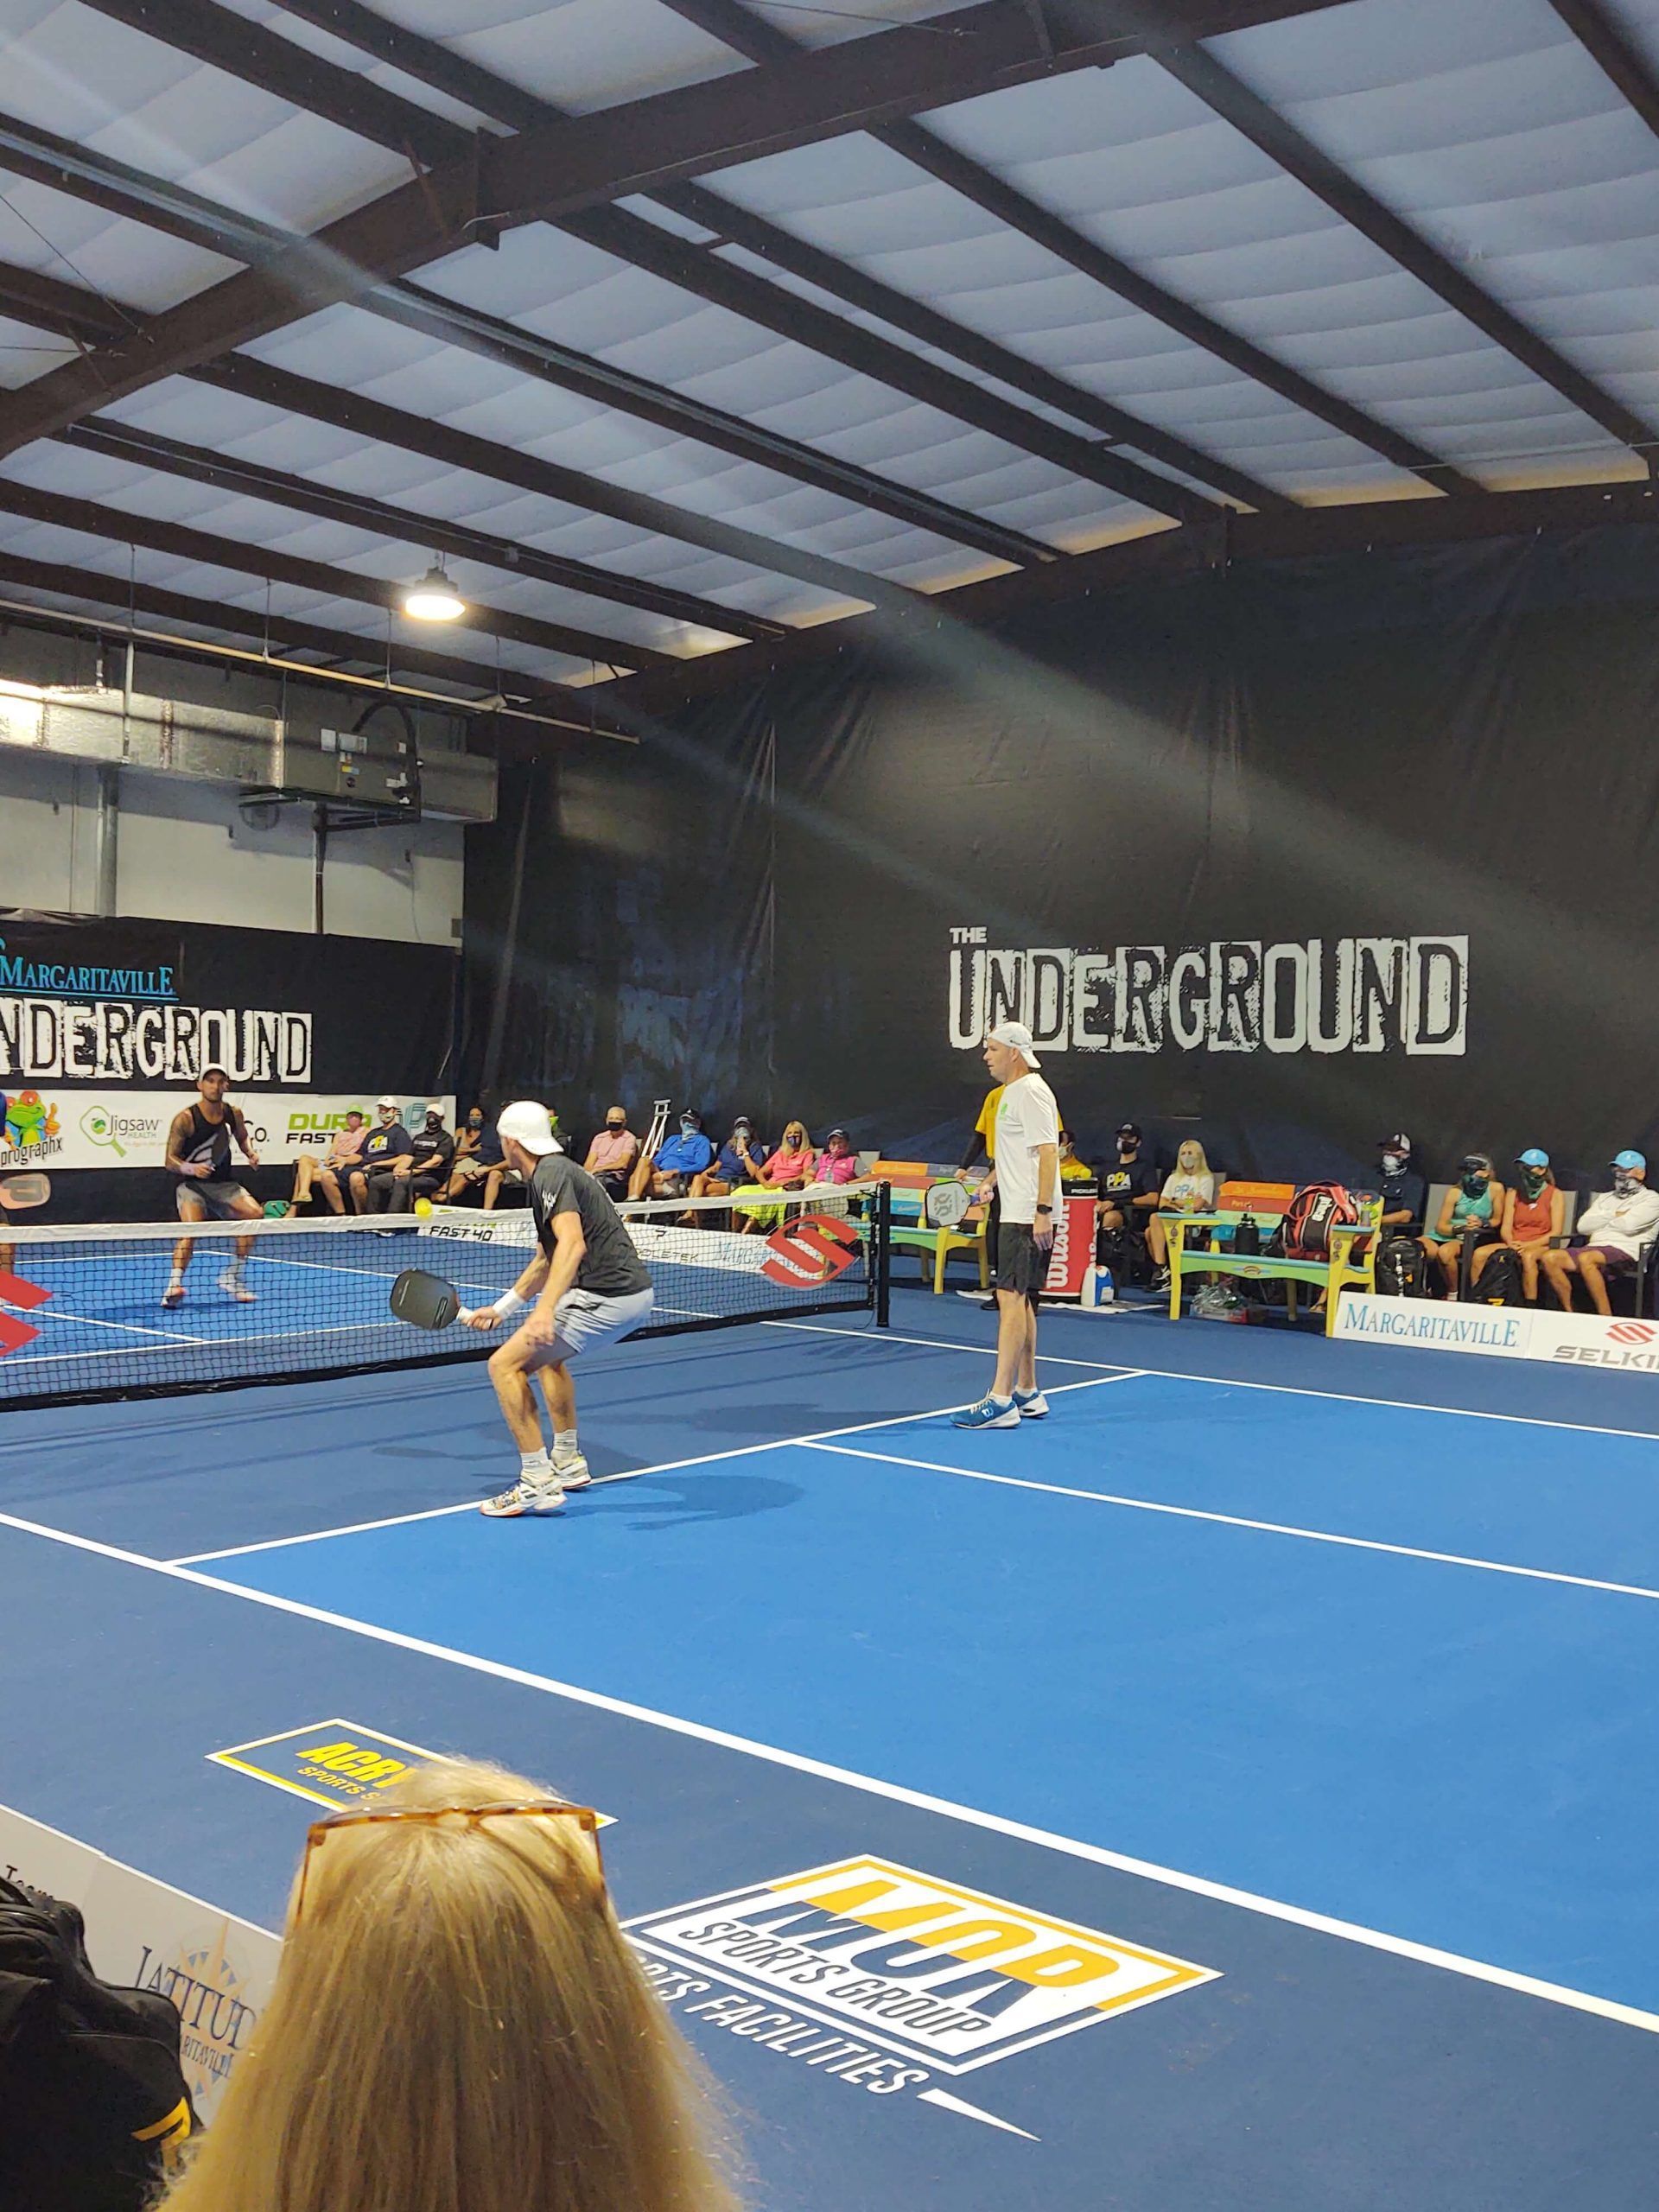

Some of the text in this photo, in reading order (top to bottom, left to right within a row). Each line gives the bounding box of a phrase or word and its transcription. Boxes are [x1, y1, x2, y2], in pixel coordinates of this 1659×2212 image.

[949, 926, 987, 944] THE
[0, 955, 175, 996] MARGARITAVILLE
[949, 934, 1470, 1057] UNDERGROUND
[106, 1115, 159, 1136] Jigsaw
[1106, 1171, 1132, 1188] PPA
[429, 1225, 493, 1242] FAST 40
[1344, 1303, 1521, 1348] MARGARITAVILLE
[1553, 1344, 1659, 1371] SELKI
[297, 1766, 366, 1795] SPORTS
[731, 1878, 1121, 2018] MOR
[677, 1922, 993, 2037] SPORTS GROUP
[683, 1994, 930, 2094] FACILITIES
